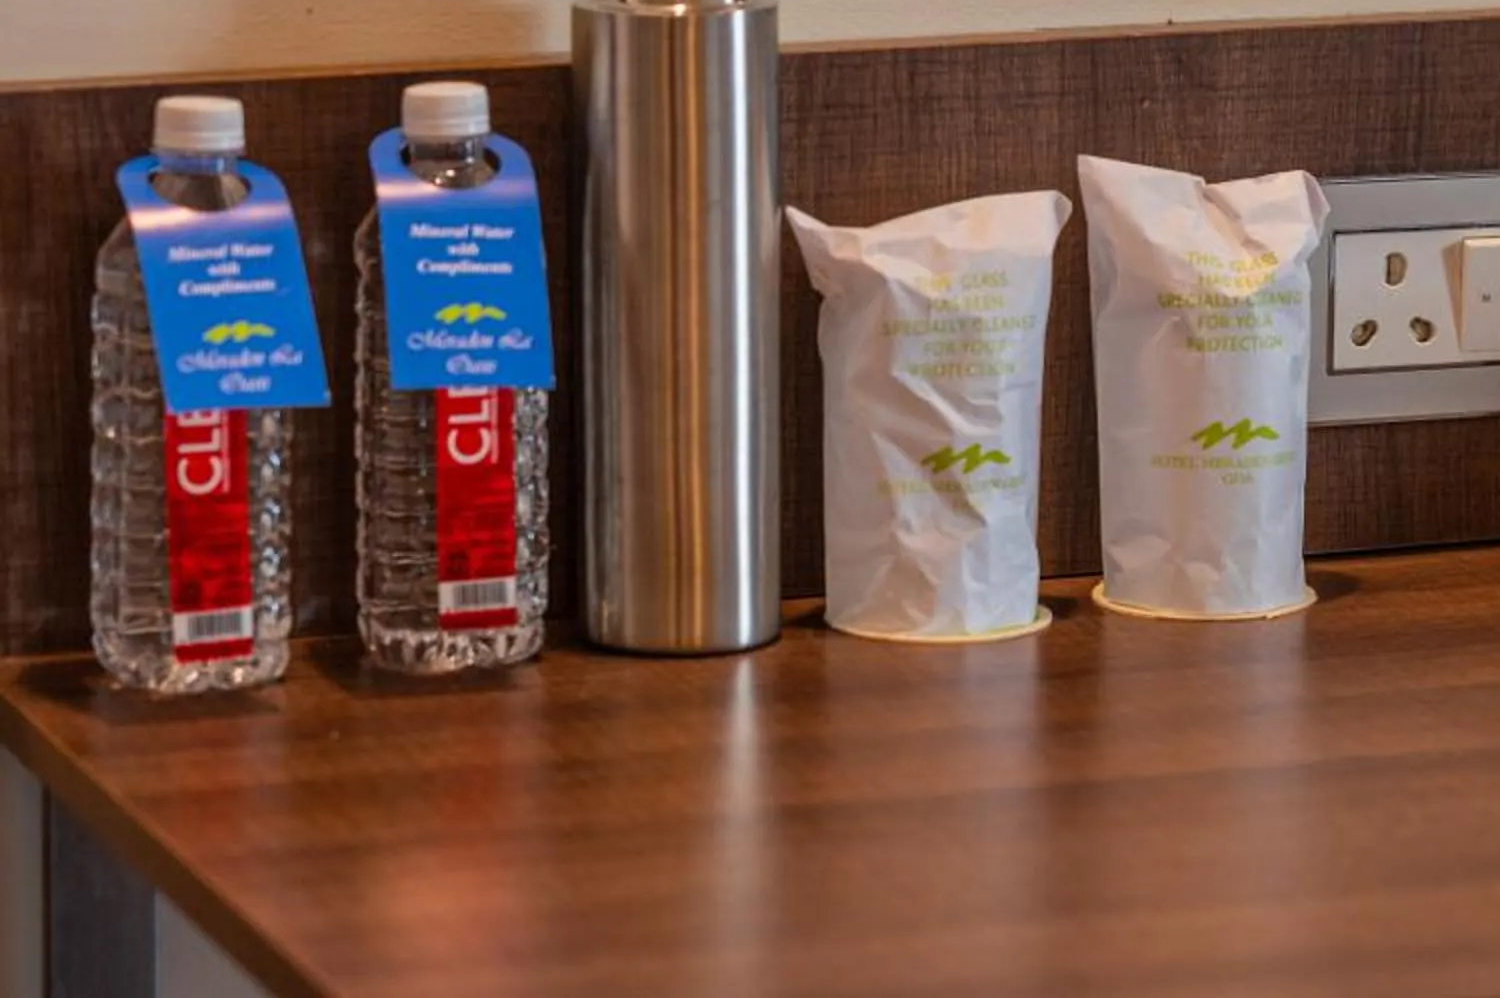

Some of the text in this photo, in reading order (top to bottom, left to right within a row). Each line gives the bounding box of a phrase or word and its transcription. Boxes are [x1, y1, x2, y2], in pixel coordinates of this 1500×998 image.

[410, 223, 515, 239] Mineral Water
[168, 243, 274, 262] Mineral Water
[447, 242, 480, 256] with
[207, 261, 241, 277] with
[1197, 313, 1230, 328] FOR
[1185, 335, 1283, 351] PROTECTION
